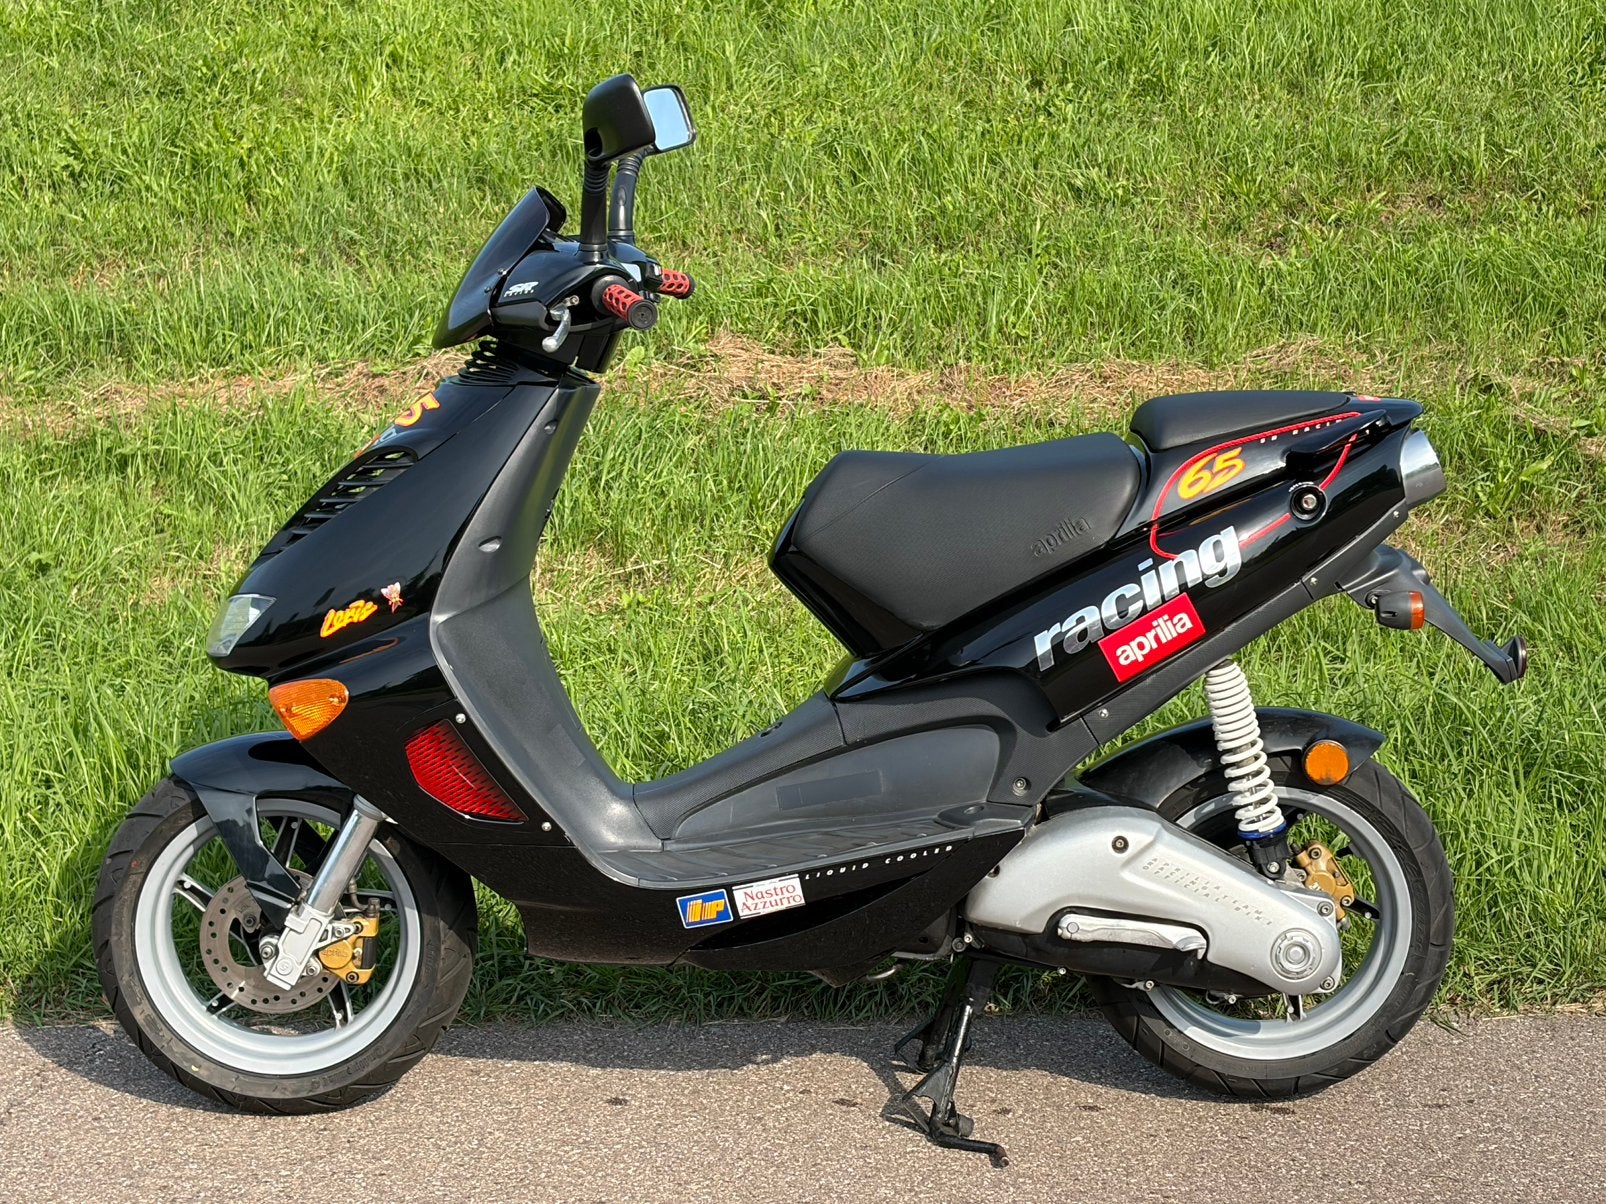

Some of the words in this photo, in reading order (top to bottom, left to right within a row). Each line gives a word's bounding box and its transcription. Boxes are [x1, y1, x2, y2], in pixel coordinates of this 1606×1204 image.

[1177, 446, 1247, 500] 65
[1030, 516, 1092, 558] aprilia
[1033, 525, 1243, 672] racing
[1115, 610, 1194, 667] aprilia
[805, 862, 869, 880] LIQUID
[885, 845, 952, 865] COOLED
[741, 894, 803, 913] Azzurro
[743, 884, 796, 903] Nastro
